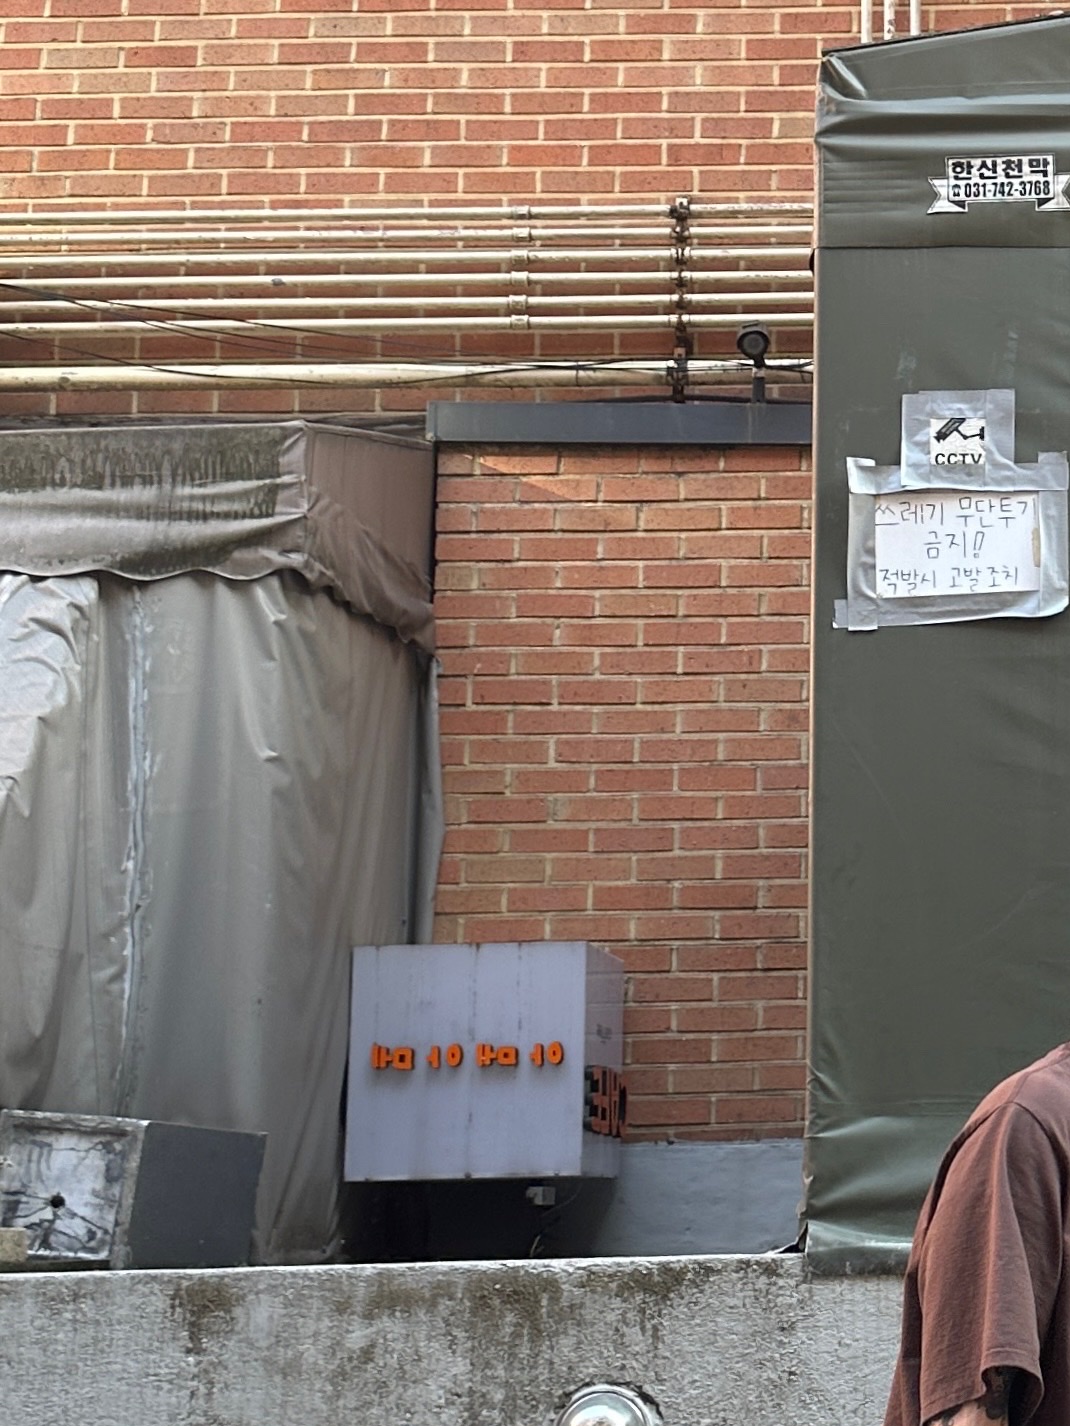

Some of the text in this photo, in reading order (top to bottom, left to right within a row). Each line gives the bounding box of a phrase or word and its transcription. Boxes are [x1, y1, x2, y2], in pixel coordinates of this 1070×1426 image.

[951, 157, 1050, 180] 한신천막
[963, 180, 1050, 198] 031-742-3768
[935, 452, 982, 465] CCTV
[874, 496, 1037, 528] 쓰레기 무단투기
[879, 568, 937, 595] 적발시
